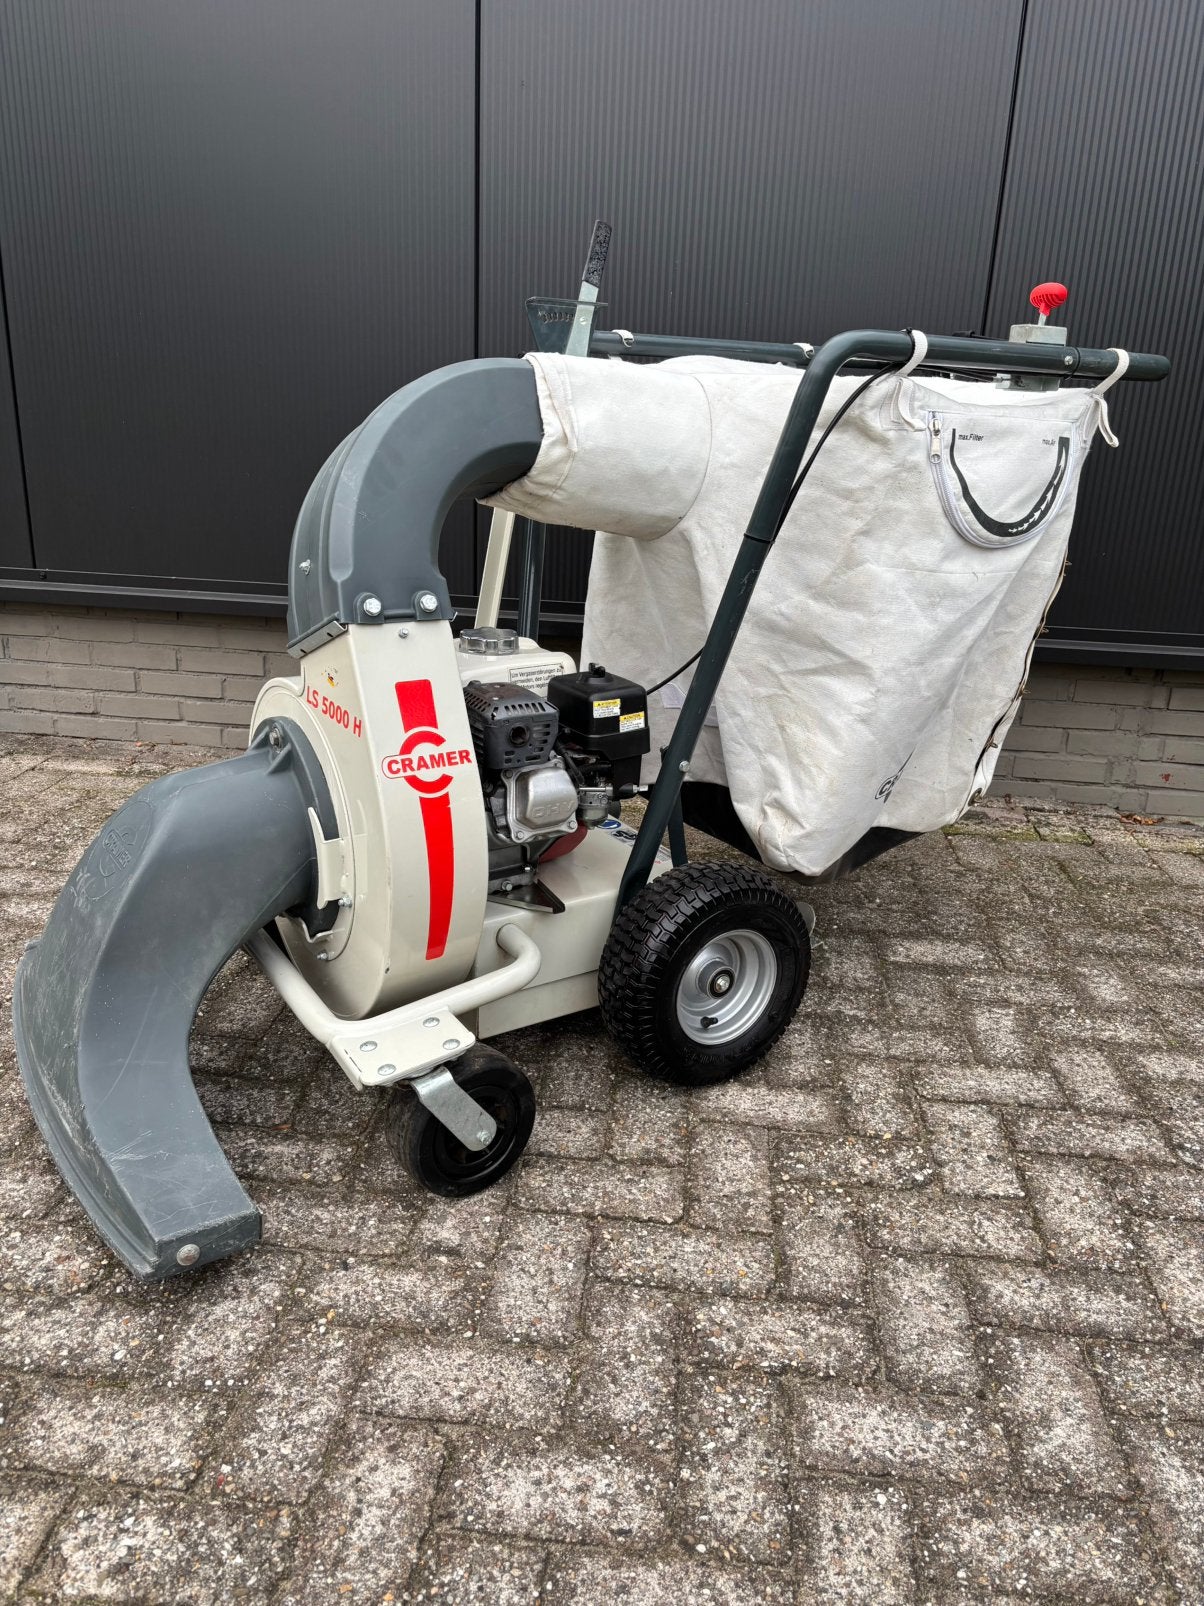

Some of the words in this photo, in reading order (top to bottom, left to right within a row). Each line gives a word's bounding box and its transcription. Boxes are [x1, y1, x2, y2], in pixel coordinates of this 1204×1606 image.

[306, 685, 319, 708] LS
[321, 696, 350, 729] 5000
[353, 716, 362, 738] H
[387, 749, 472, 775] CRAMER
